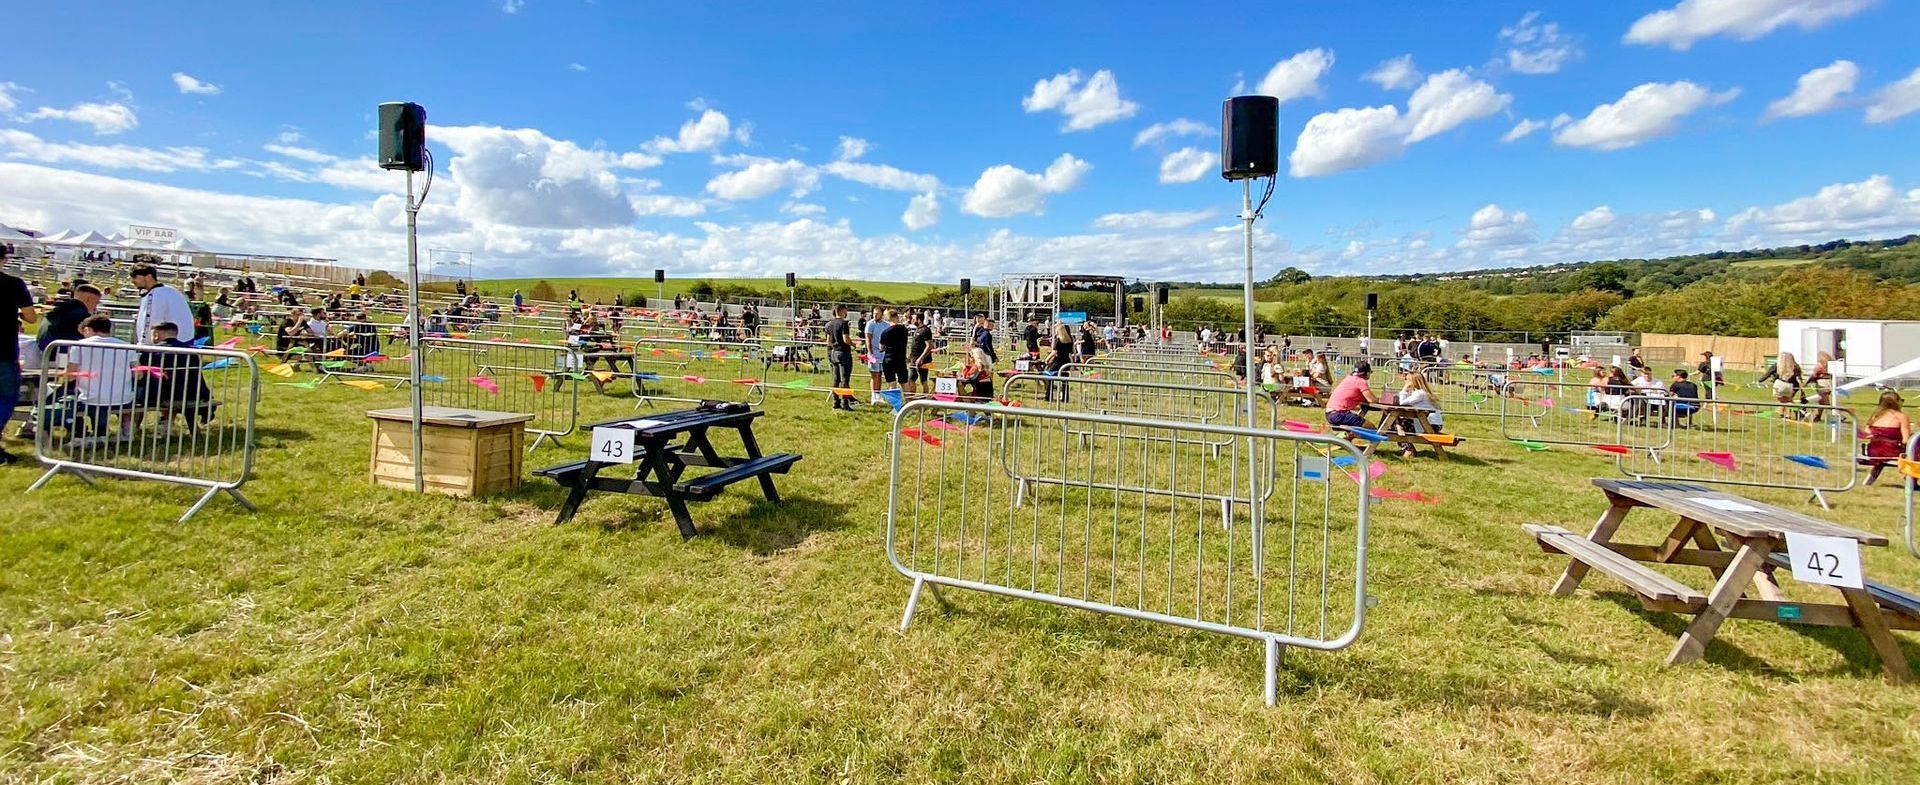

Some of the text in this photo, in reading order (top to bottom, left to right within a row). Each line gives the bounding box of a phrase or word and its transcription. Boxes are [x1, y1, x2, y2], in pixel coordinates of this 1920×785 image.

[135, 228, 173, 238] VIP BAR
[1007, 279, 1053, 303] VIP
[941, 382, 952, 391] 33
[602, 440, 623, 457] 43
[1807, 551, 1843, 579] 42
